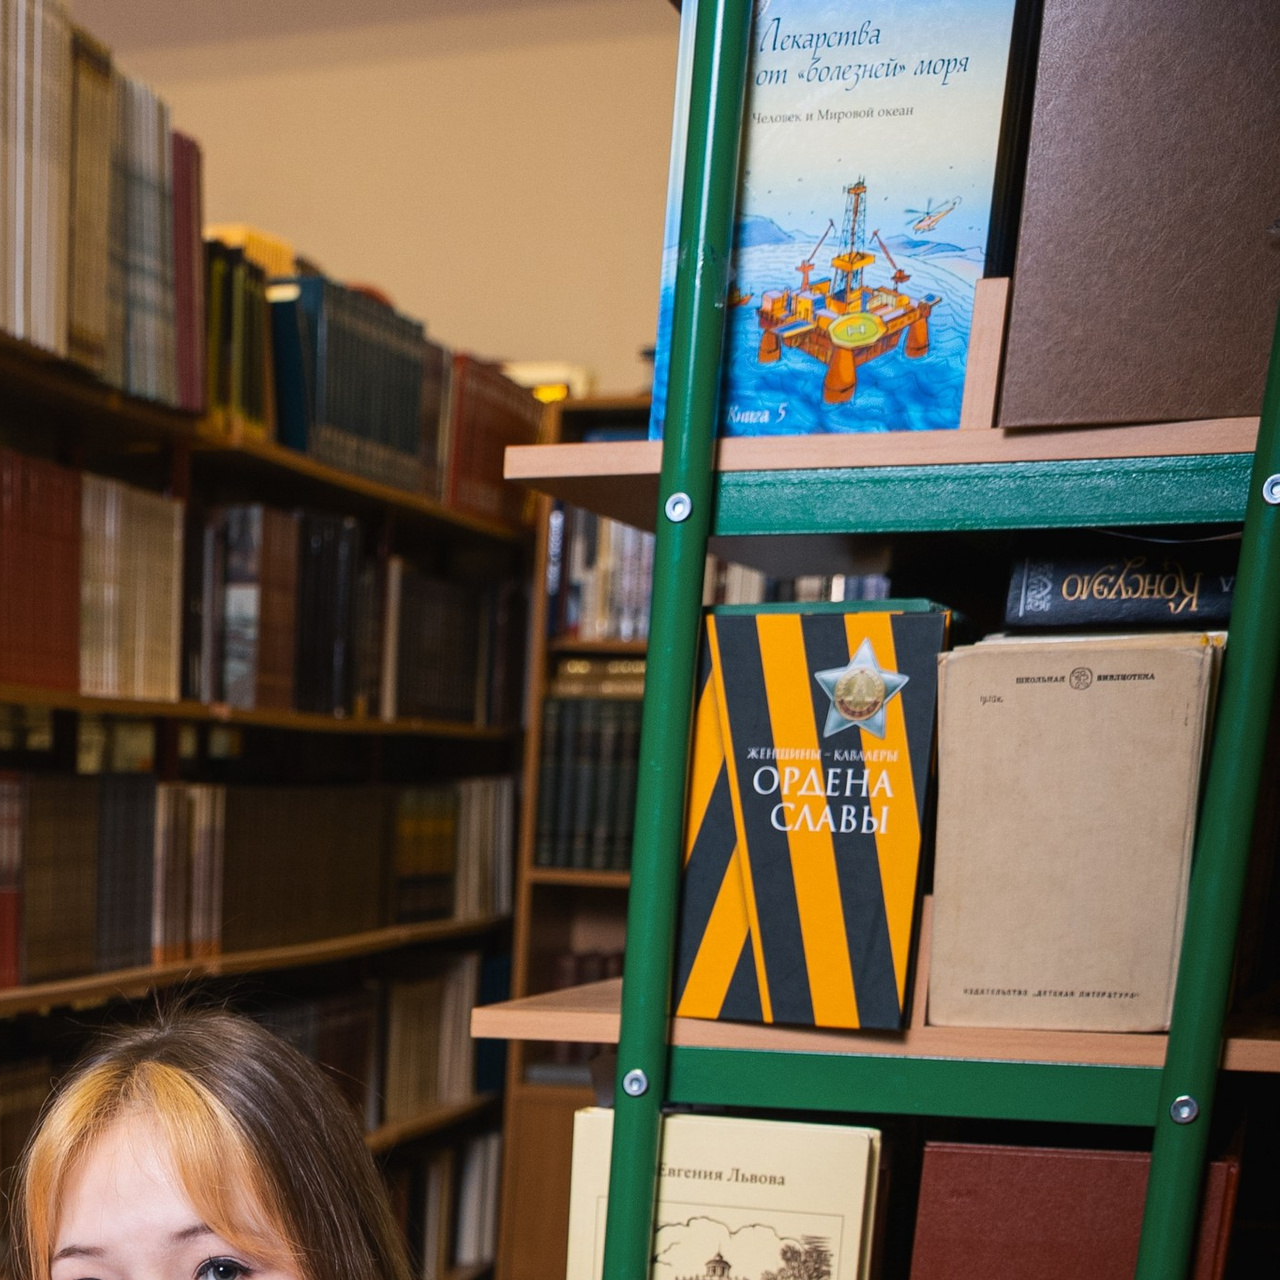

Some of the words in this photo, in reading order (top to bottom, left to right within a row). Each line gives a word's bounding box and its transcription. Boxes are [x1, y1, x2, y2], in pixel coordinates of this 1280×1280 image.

[759, 17, 882, 62] Лекарства
[755, 71, 788, 86] от
[797, 57, 907, 91] «болезней»
[913, 56, 970, 86] моря
[752, 112, 802, 125] Человек
[805, 113, 814, 122] и
[817, 107, 874, 123] Мировой
[877, 106, 914, 118] океан
[727, 404, 770, 424] Книга
[774, 401, 789, 424] 5
[1015, 675, 1066, 684] ШКОЛЬНАЯ
[1096, 672, 1156, 682] БИБЛИОТЕКА
[746, 747, 822, 760] ЖЕНЩИНЫ
[833, 748, 899, 762] КАВАЛЕРЫ
[752, 765, 894, 798] ОРДЕНА
[770, 802, 889, 835] СЛАВЫ
[657, 1162, 723, 1181] Евгения
[726, 1167, 786, 1186] Львова
